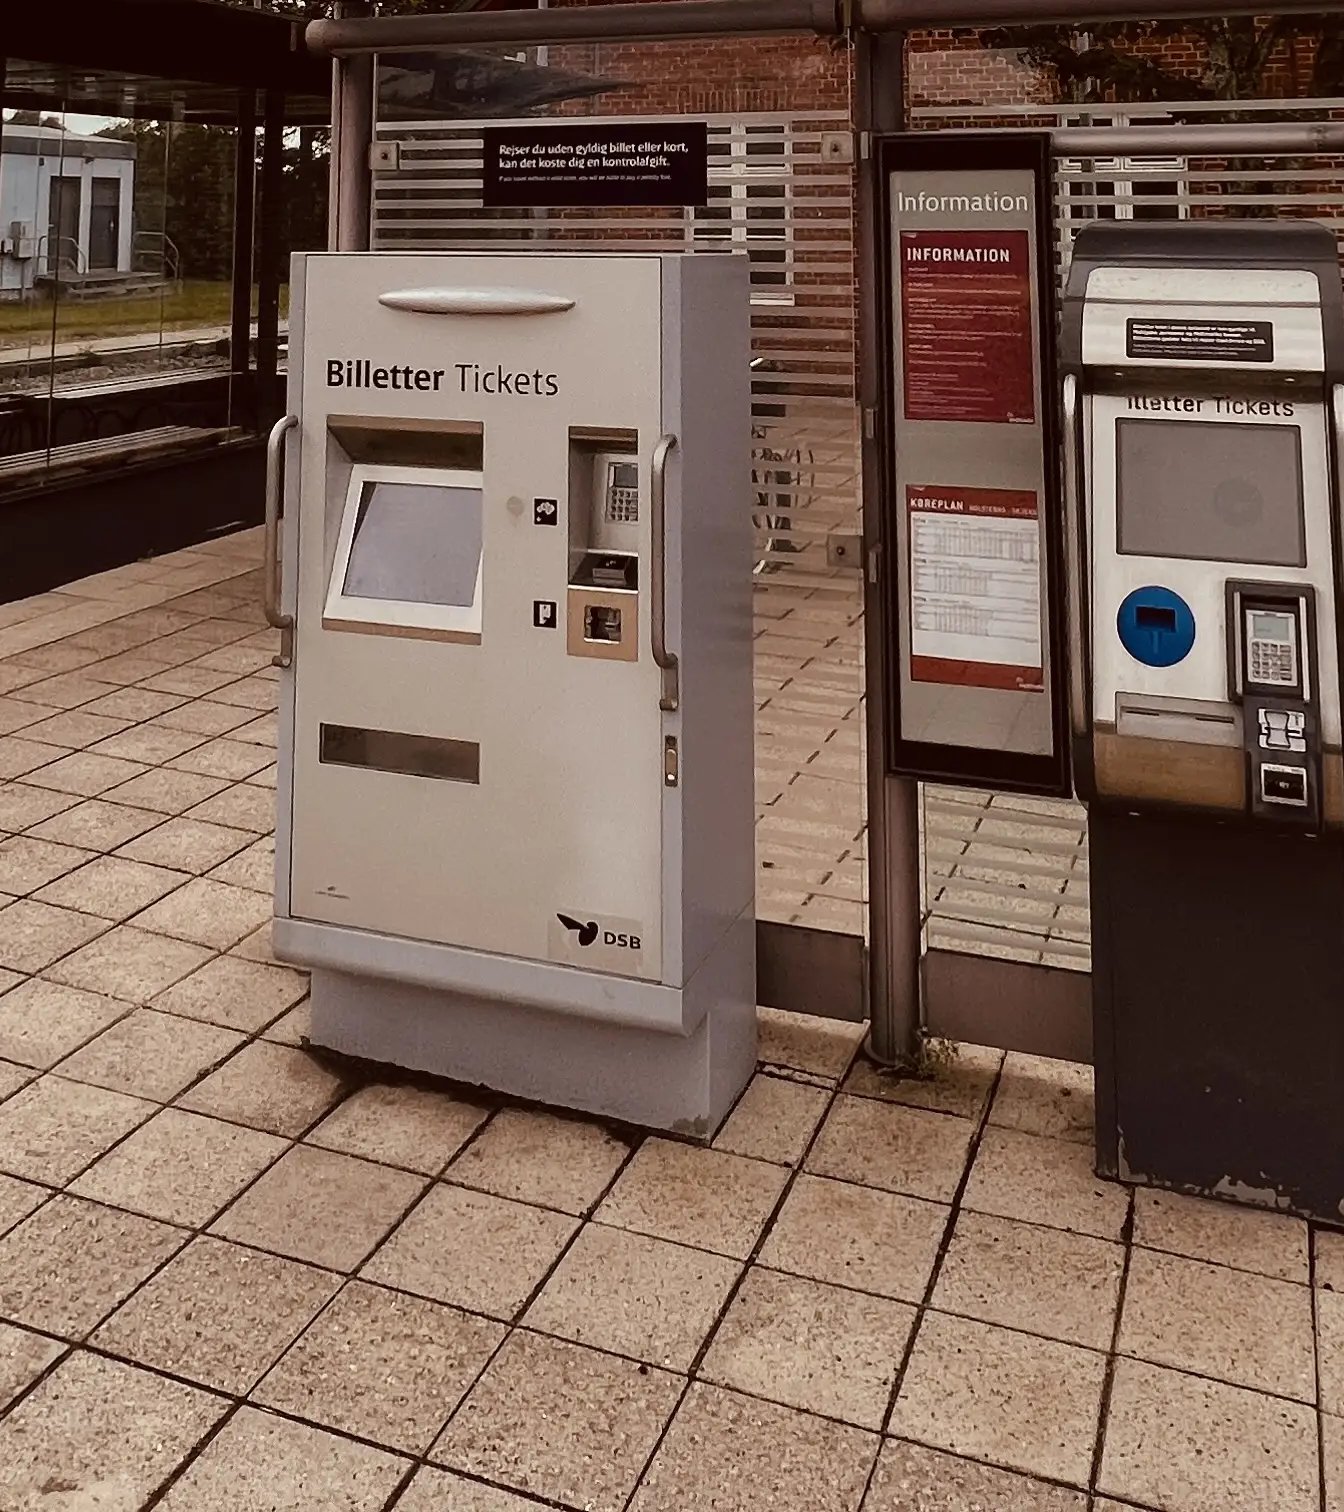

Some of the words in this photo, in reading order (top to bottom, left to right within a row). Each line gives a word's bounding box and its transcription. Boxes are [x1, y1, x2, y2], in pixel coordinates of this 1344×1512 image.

[499, 144, 531, 156] Rejser
[532, 144, 546, 154] du
[548, 144, 573, 154] uden
[575, 143, 607, 156] gyldig
[609, 142, 636, 153] billet
[638, 141, 661, 153] eller
[663, 141, 689, 153] kort,
[499, 157, 518, 168] kan
[520, 157, 537, 168] det
[538, 157, 567, 168] koste
[568, 157, 585, 169] dig
[587, 158, 600, 168] en
[602, 156, 671, 169] kontrolafgift.
[898, 191, 1029, 212] Information
[907, 247, 1010, 263] INFORMATION
[326, 359, 445, 391] Billetter
[455, 364, 560, 396] Tickets
[1212, 395, 1295, 417] Tickets
[604, 931, 641, 949] DSB
